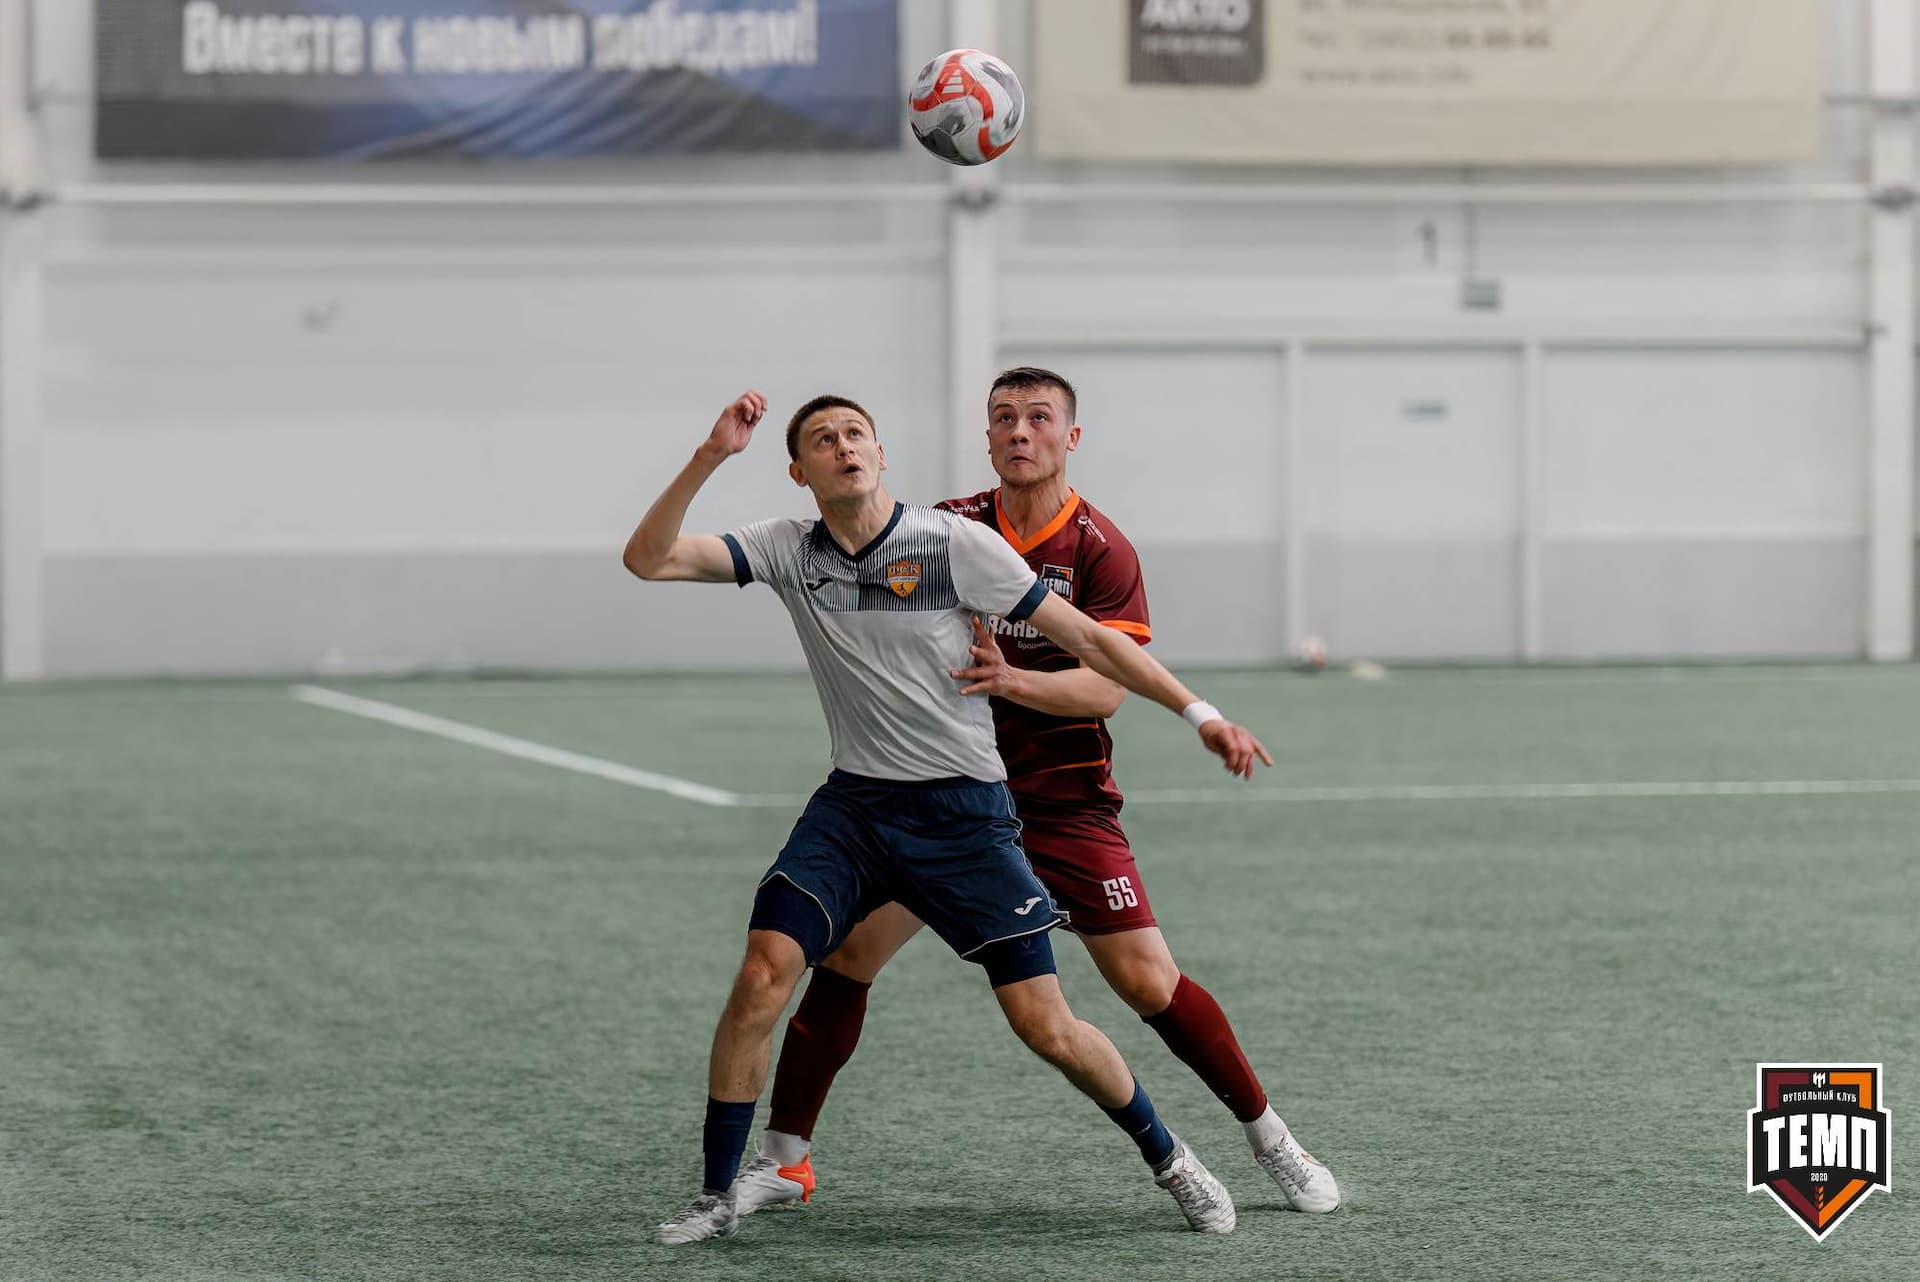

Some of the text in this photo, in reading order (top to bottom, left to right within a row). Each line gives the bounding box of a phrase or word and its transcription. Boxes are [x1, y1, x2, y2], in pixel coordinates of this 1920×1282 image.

[183, 0, 364, 73] Вместе
[372, 16, 405, 72] к
[413, 15, 584, 71] новым
[1103, 876, 1138, 911] 55
